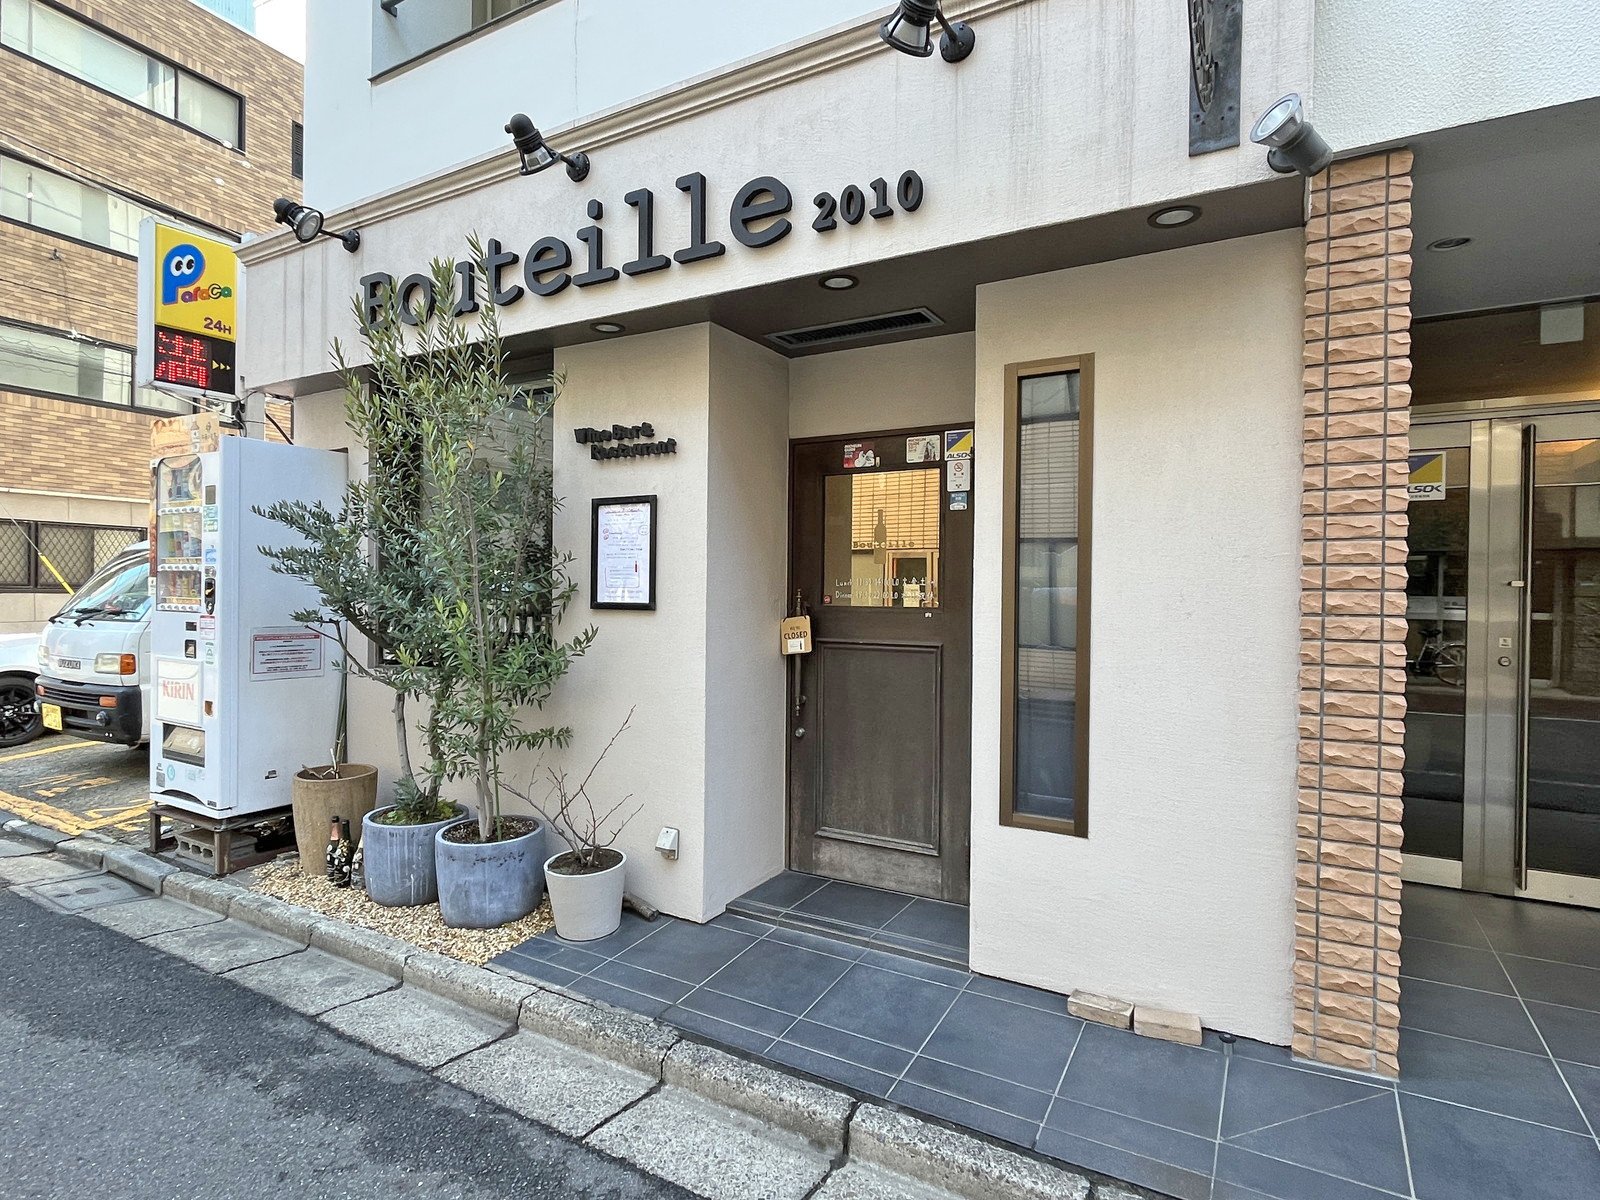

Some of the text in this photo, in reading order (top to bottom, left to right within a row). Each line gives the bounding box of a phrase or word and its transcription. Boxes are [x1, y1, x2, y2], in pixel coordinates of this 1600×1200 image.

[812, 169, 924, 232] 2010
[203, 317, 232, 335] 24H
[1407, 484, 1443, 494] LSOK
[783, 631, 808, 640] CLOSED
[162, 679, 195, 701] KIRIN
